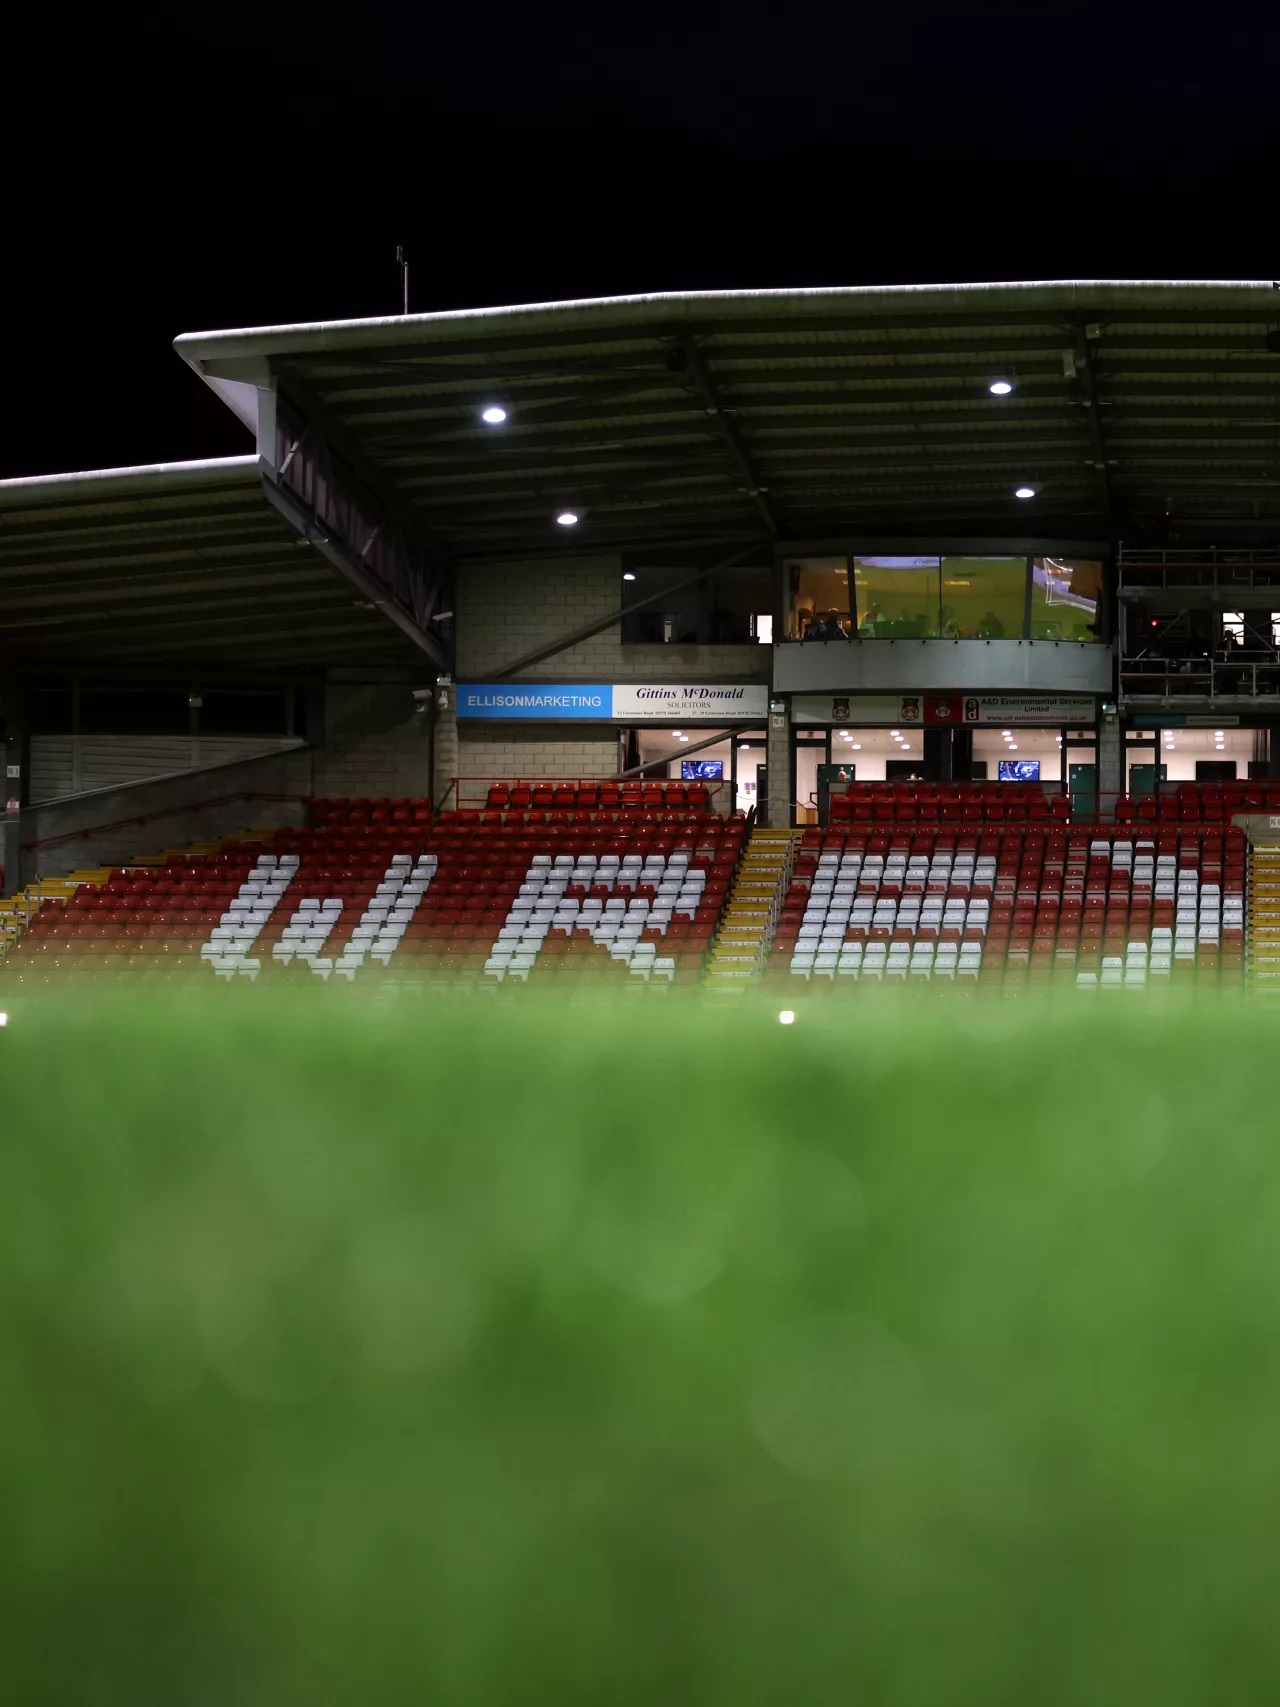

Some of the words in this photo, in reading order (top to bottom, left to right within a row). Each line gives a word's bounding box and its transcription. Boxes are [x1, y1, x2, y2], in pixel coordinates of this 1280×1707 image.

[636, 688, 677, 699] Gittins
[681, 688, 744, 699] McDonald
[467, 695, 602, 707] ELLISONMARKETING
